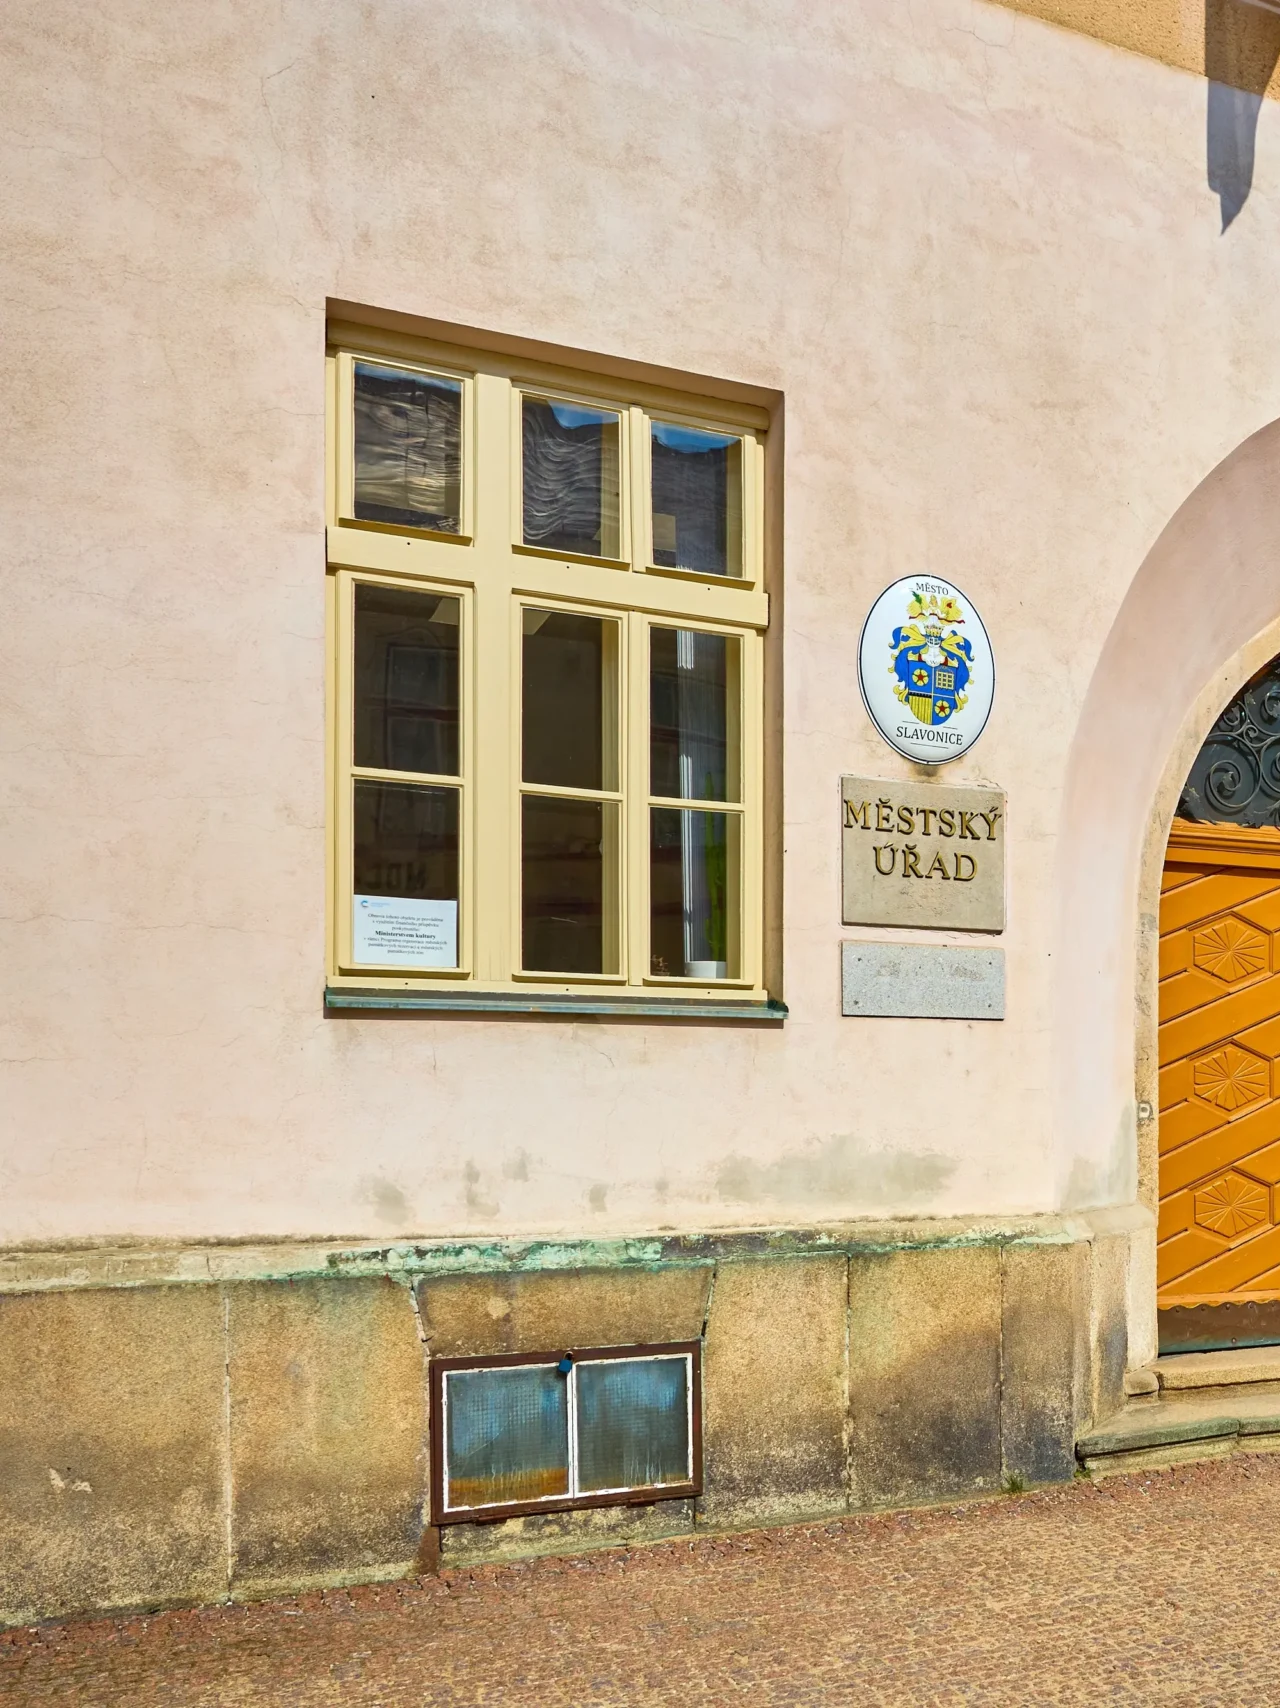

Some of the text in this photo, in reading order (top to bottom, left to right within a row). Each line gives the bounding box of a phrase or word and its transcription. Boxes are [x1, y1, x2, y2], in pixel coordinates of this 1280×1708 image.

[915, 582, 949, 596] MĚSTO
[896, 725, 964, 746] SLAVONICE
[843, 797, 1003, 841] MĚSTSKÝ
[872, 842, 979, 882] ÚŘAD
